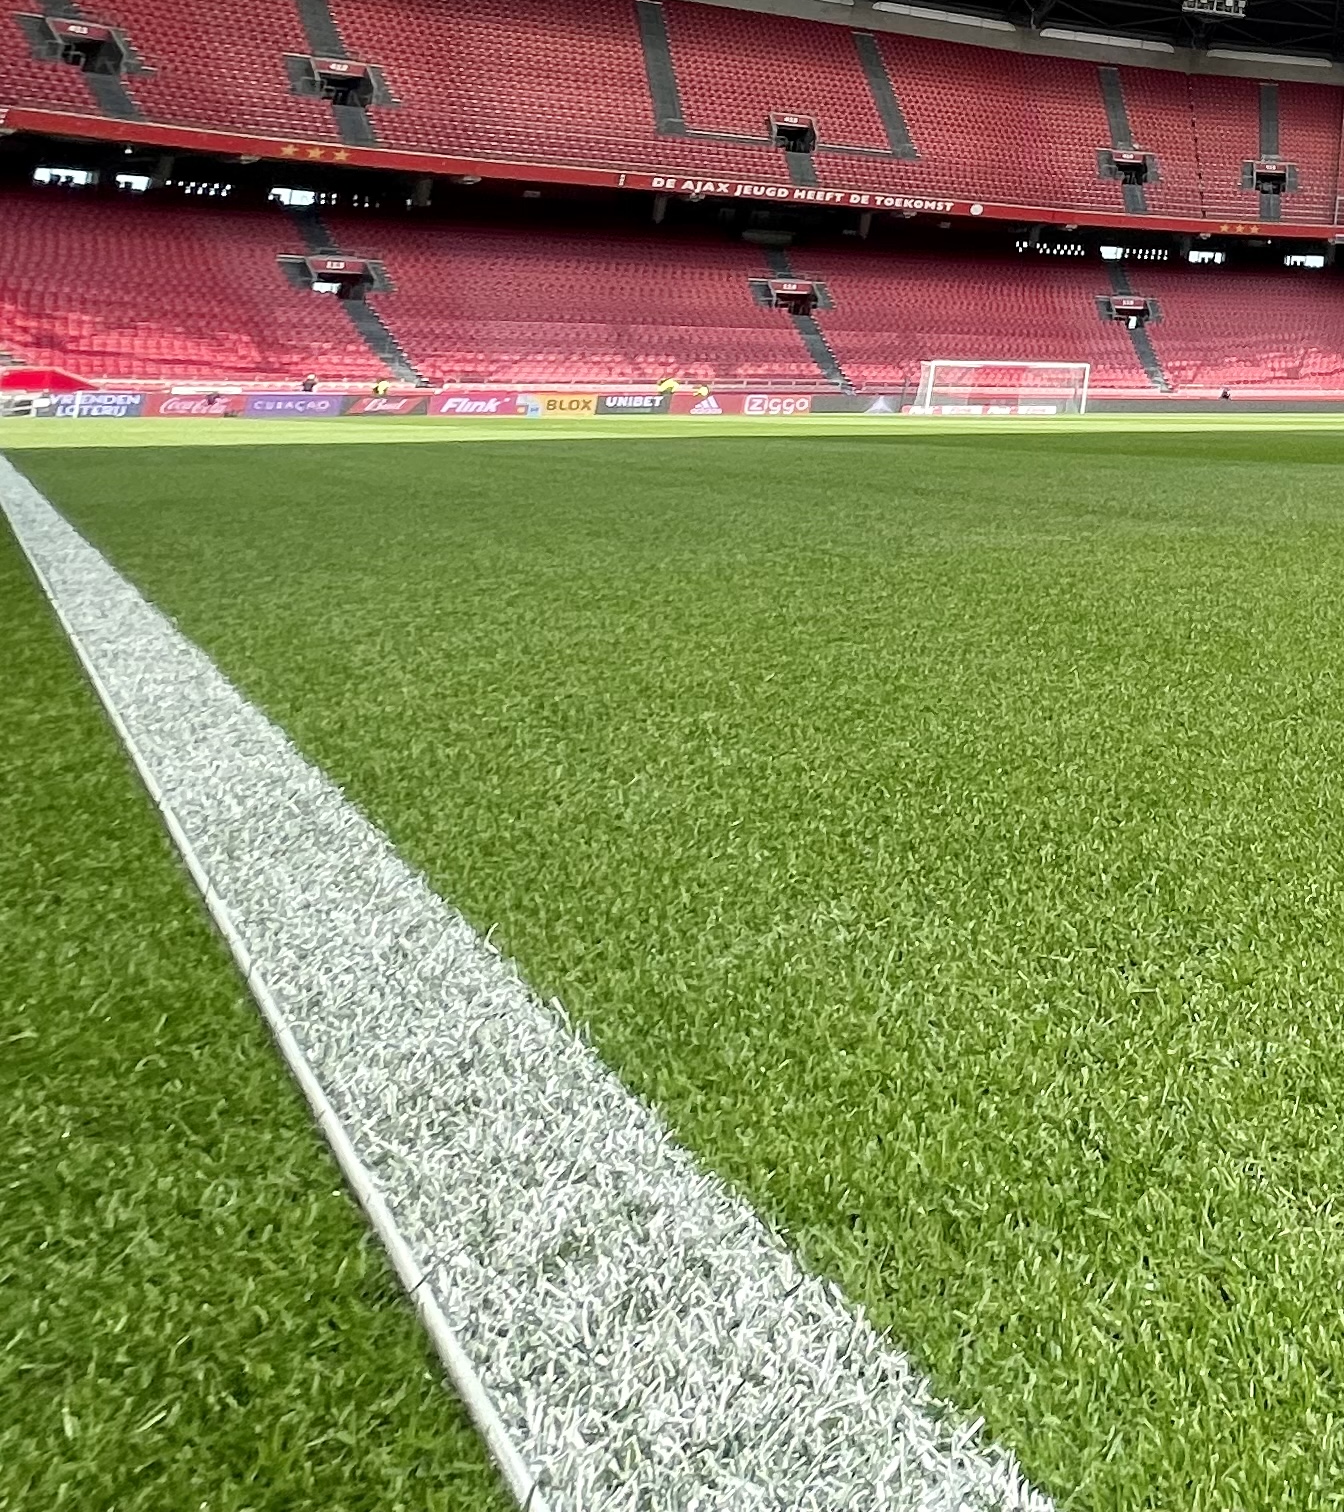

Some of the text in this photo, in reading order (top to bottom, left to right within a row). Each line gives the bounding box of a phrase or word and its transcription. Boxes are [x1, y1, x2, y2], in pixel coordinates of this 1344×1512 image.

[651, 177, 955, 212] DE AJAX JEUGD HEEFT DE TOEKOMST
[50, 393, 141, 405] VRENDEN
[440, 397, 502, 414] Flink
[546, 399, 592, 411] BLOX
[605, 395, 664, 408] UNIBET
